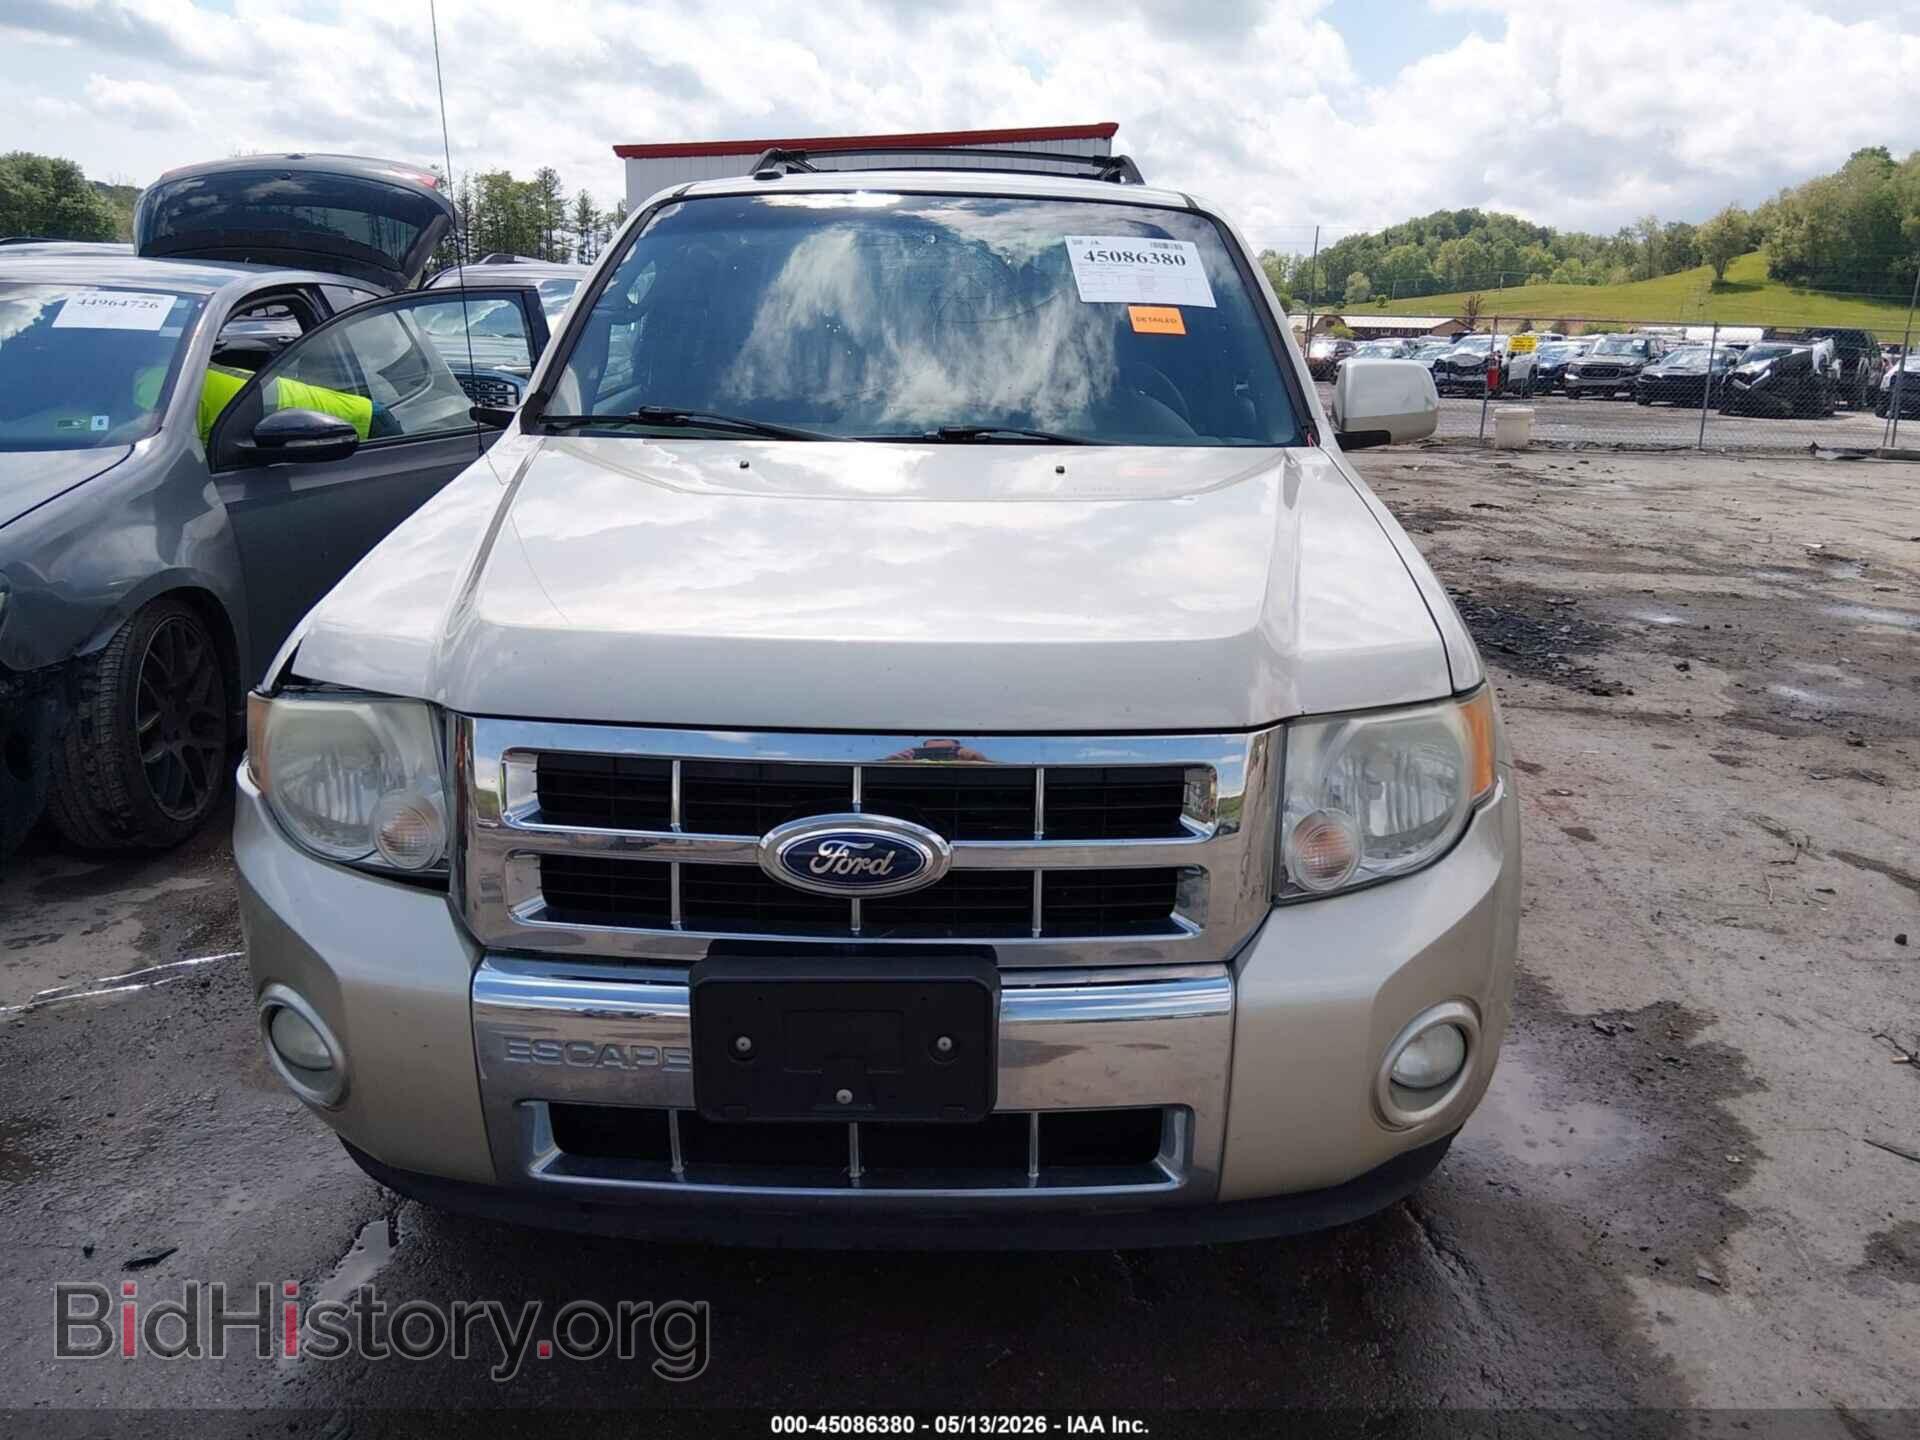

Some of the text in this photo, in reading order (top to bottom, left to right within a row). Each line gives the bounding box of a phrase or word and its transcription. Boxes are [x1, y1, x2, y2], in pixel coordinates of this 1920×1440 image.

[1083, 249, 1187, 267] 45086380
[77, 298, 159, 310] 44964726
[809, 839, 896, 876] Ford
[503, 1036, 692, 1073] ESCAPE
